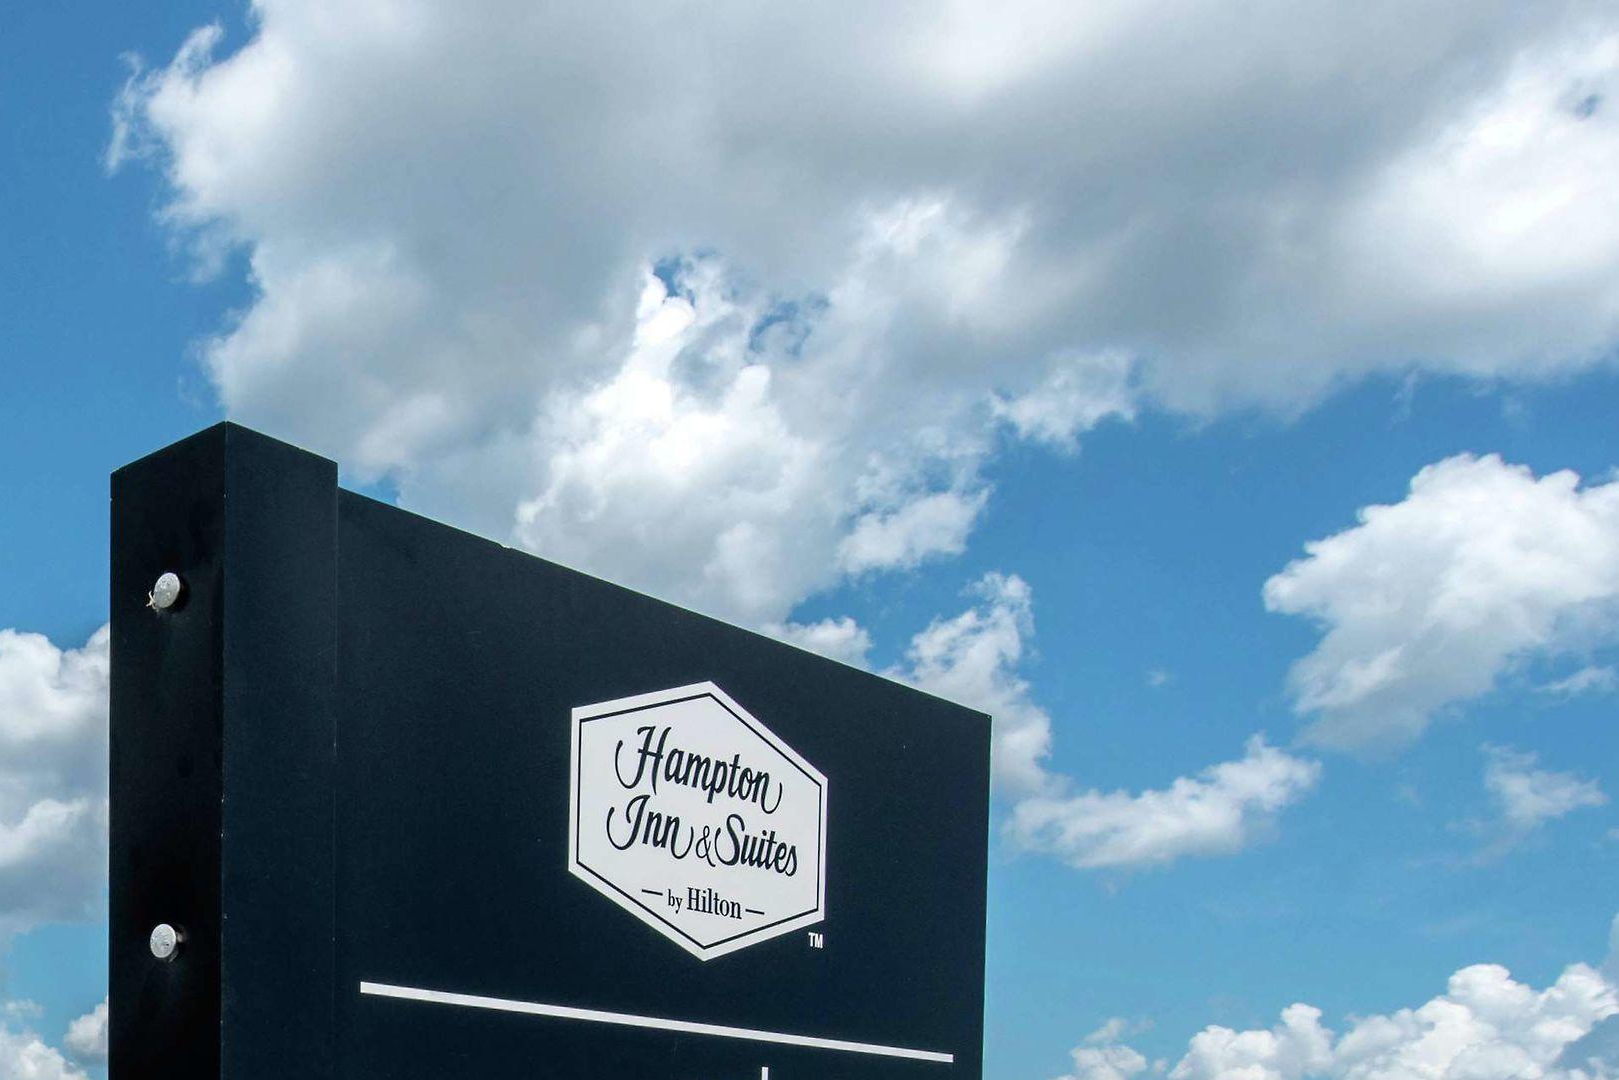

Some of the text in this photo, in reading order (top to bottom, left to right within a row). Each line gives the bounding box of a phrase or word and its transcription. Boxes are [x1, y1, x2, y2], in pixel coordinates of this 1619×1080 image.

[615, 725, 782, 814] Hampton
[607, 795, 798, 877] Inn & Suites
[668, 887, 742, 920] by Hilton
